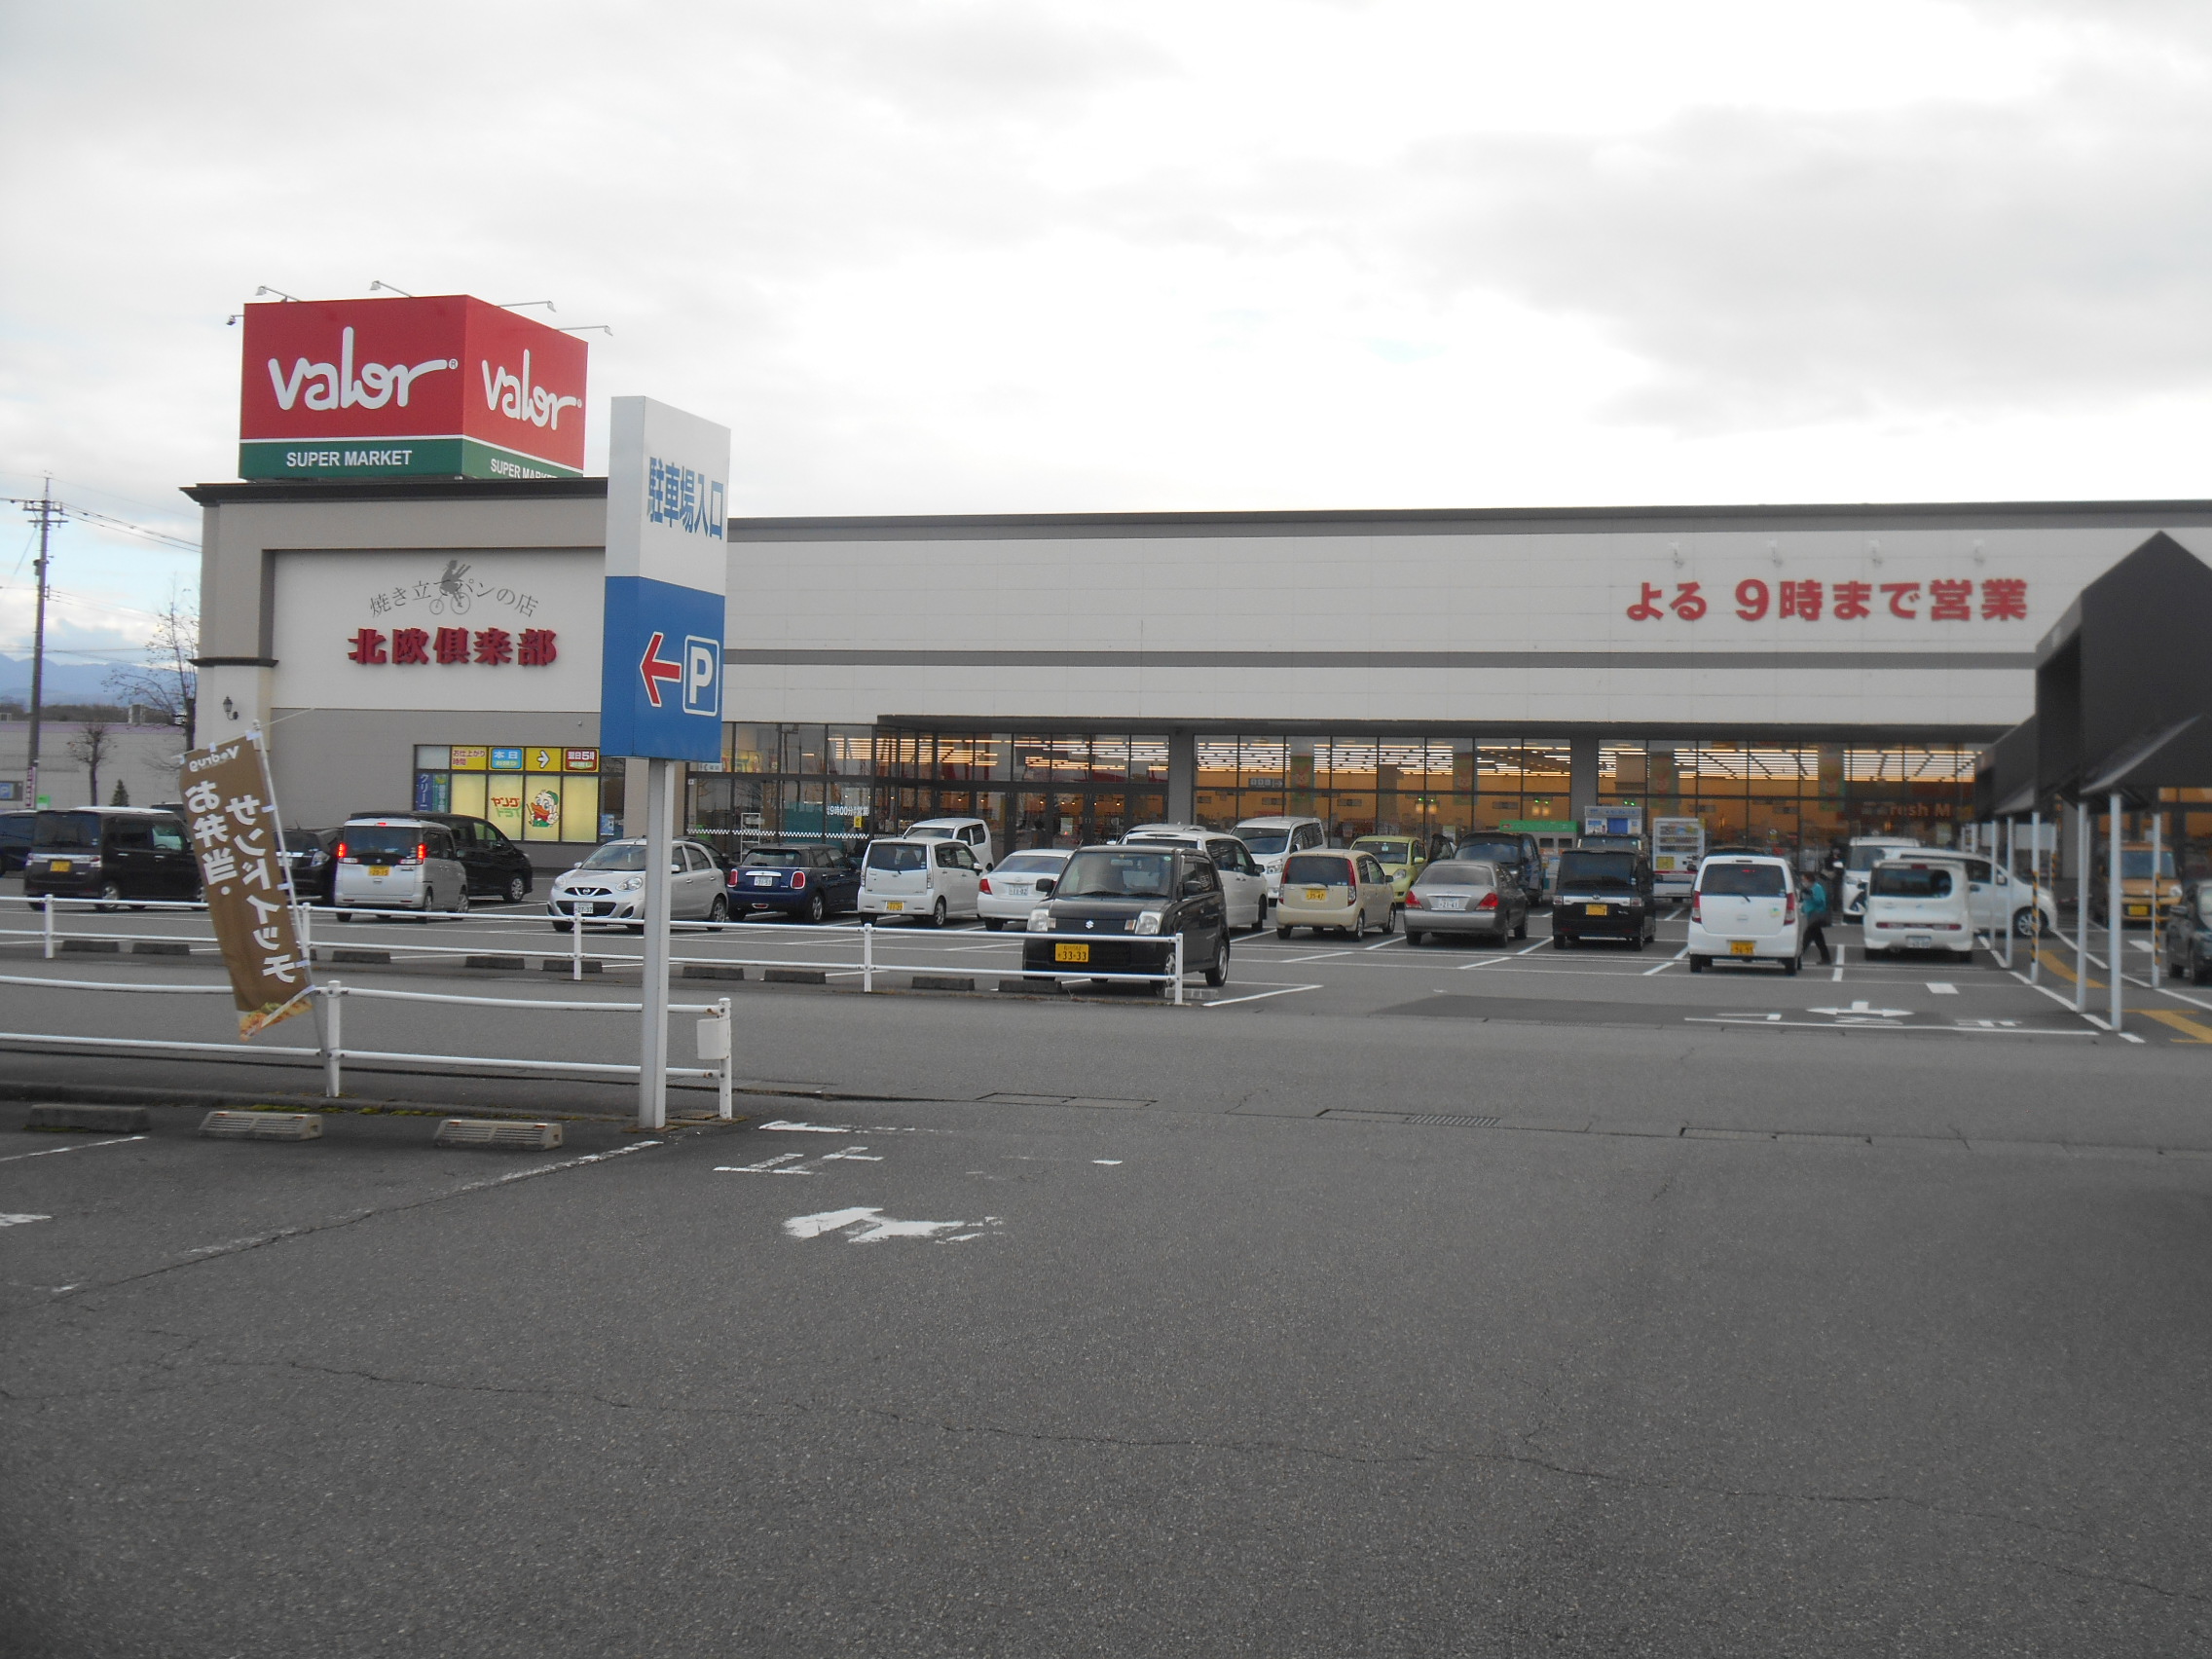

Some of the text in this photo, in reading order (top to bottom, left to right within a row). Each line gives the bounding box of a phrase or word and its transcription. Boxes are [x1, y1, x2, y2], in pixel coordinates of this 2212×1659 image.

[286, 450, 413, 467] SUPER MARKET
[491, 458, 521, 478] SUPER
[646, 456, 724, 540] 駐車場入口
[1626, 578, 2028, 621] よる 9時まで営業
[348, 627, 558, 666] 北欧倶楽部
[688, 645, 714, 705] P
[495, 751, 518, 759] 本日
